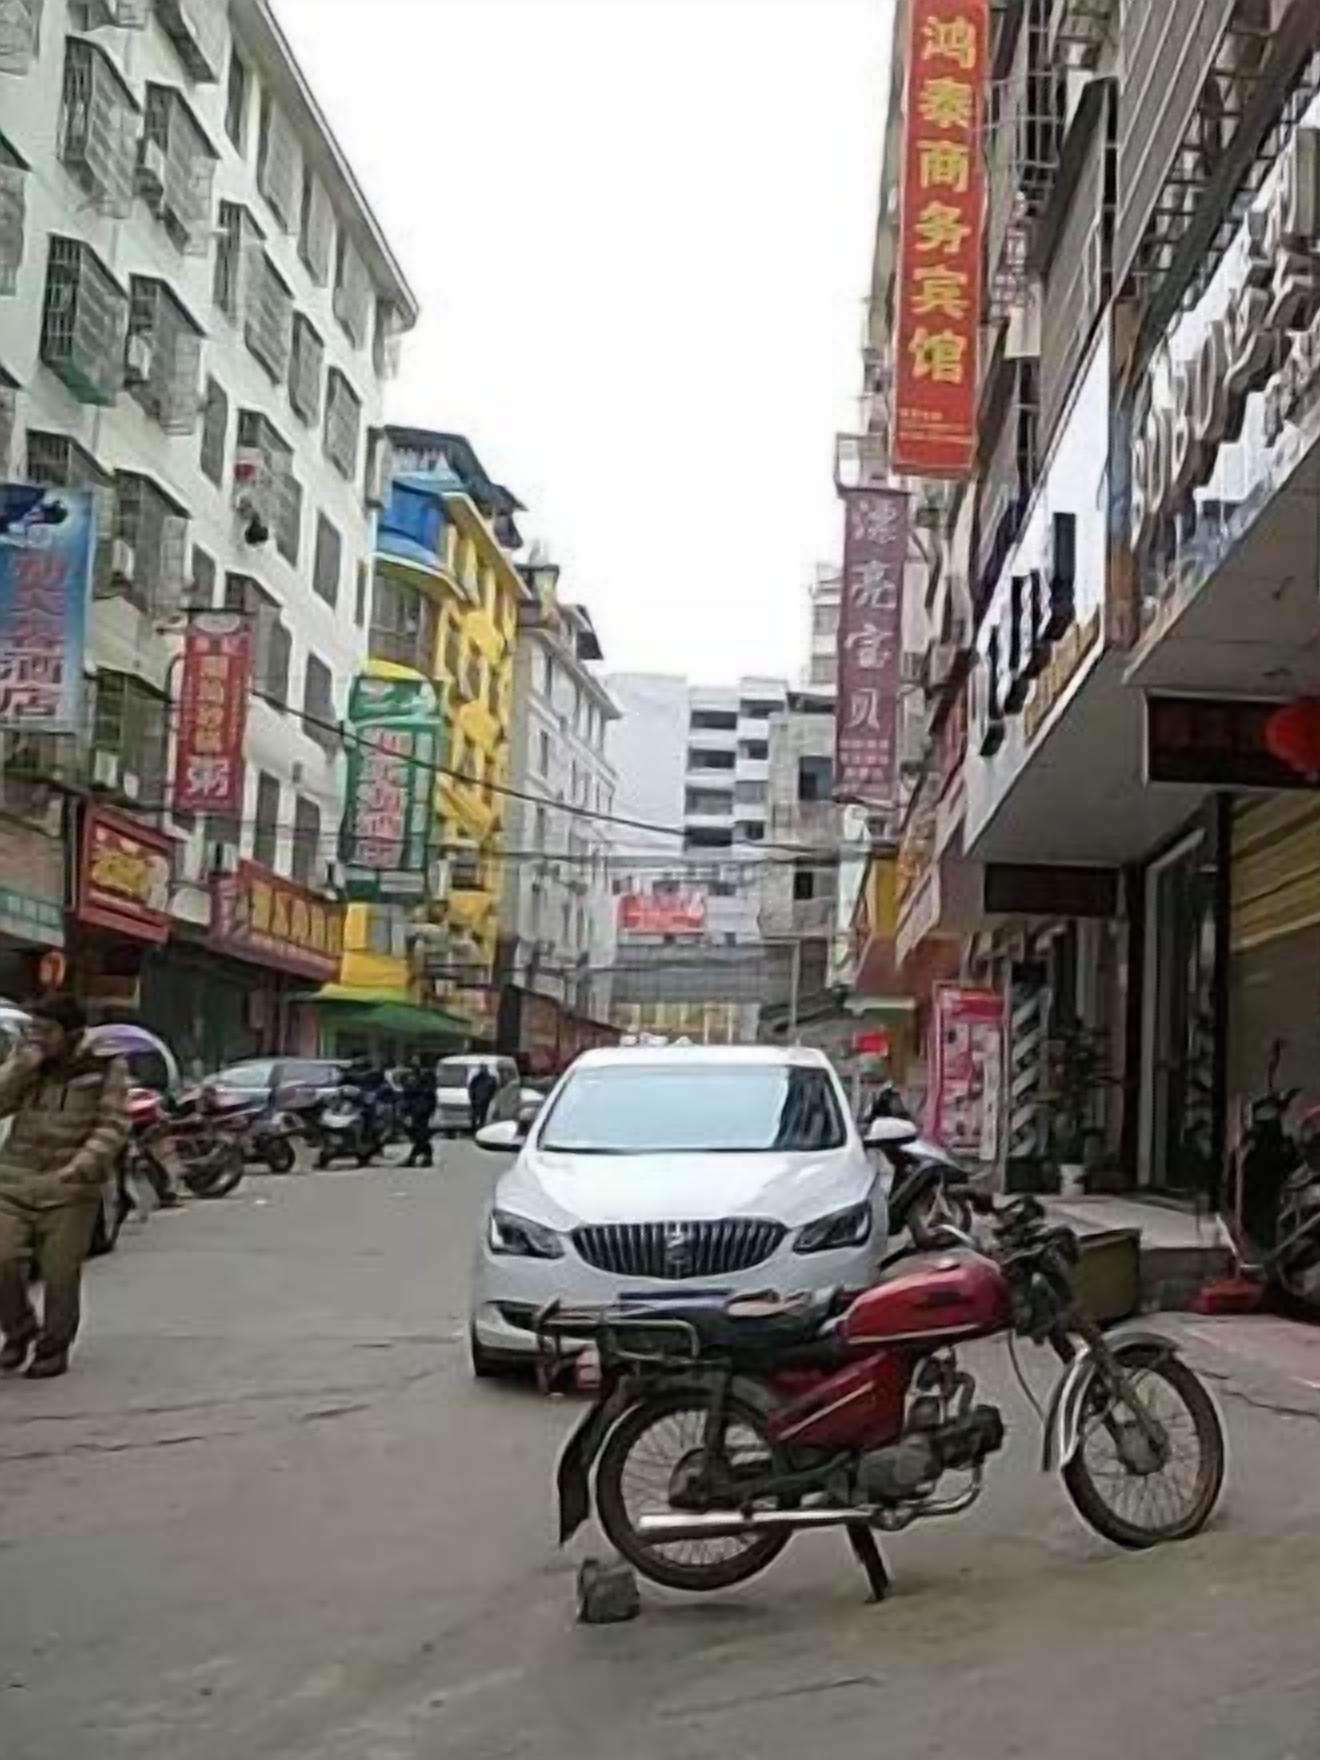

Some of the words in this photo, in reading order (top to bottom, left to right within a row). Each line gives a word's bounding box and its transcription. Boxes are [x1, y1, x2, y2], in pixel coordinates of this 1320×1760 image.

[909, 15, 977, 384] 鸿泰商务宾馆
